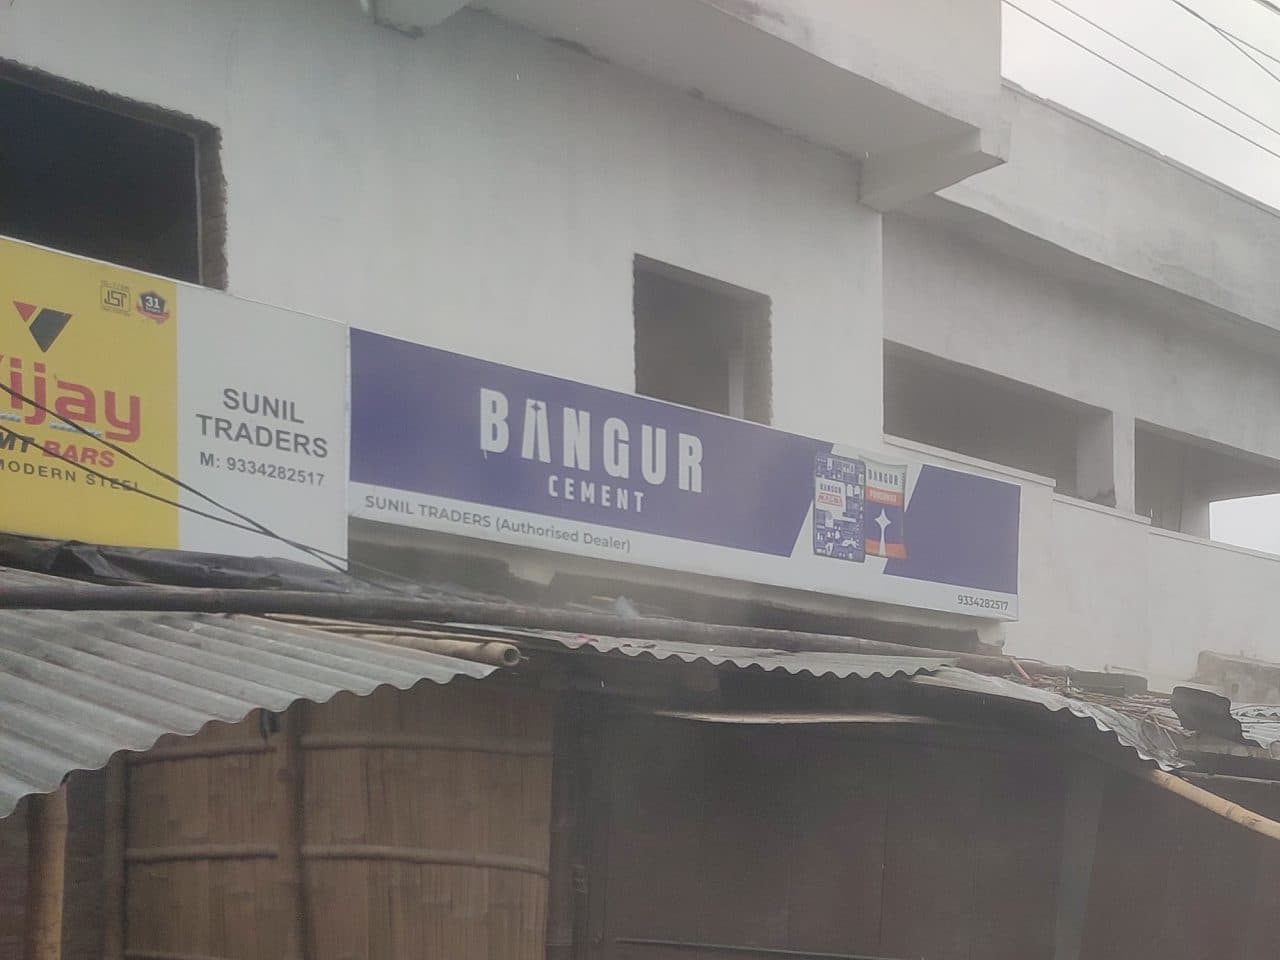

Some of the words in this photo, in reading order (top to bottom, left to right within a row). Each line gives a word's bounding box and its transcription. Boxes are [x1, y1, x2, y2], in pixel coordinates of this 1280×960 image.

[0, 354, 141, 443] ijay
[222, 387, 305, 425] SUNIL
[42, 440, 114, 468] BARS
[195, 413, 328, 459] TRADERS
[480, 388, 703, 493] BANGUR
[199, 451, 220, 469] M:
[225, 456, 325, 486] 9334282517
[549, 475, 645, 513] CEMENT
[364, 494, 414, 516] SUNIL
[418, 503, 492, 529] TRADERS
[495, 517, 579, 543] (Authorised
[583, 532, 631, 553] Dealer)
[957, 594, 1009, 611] 9334282517
